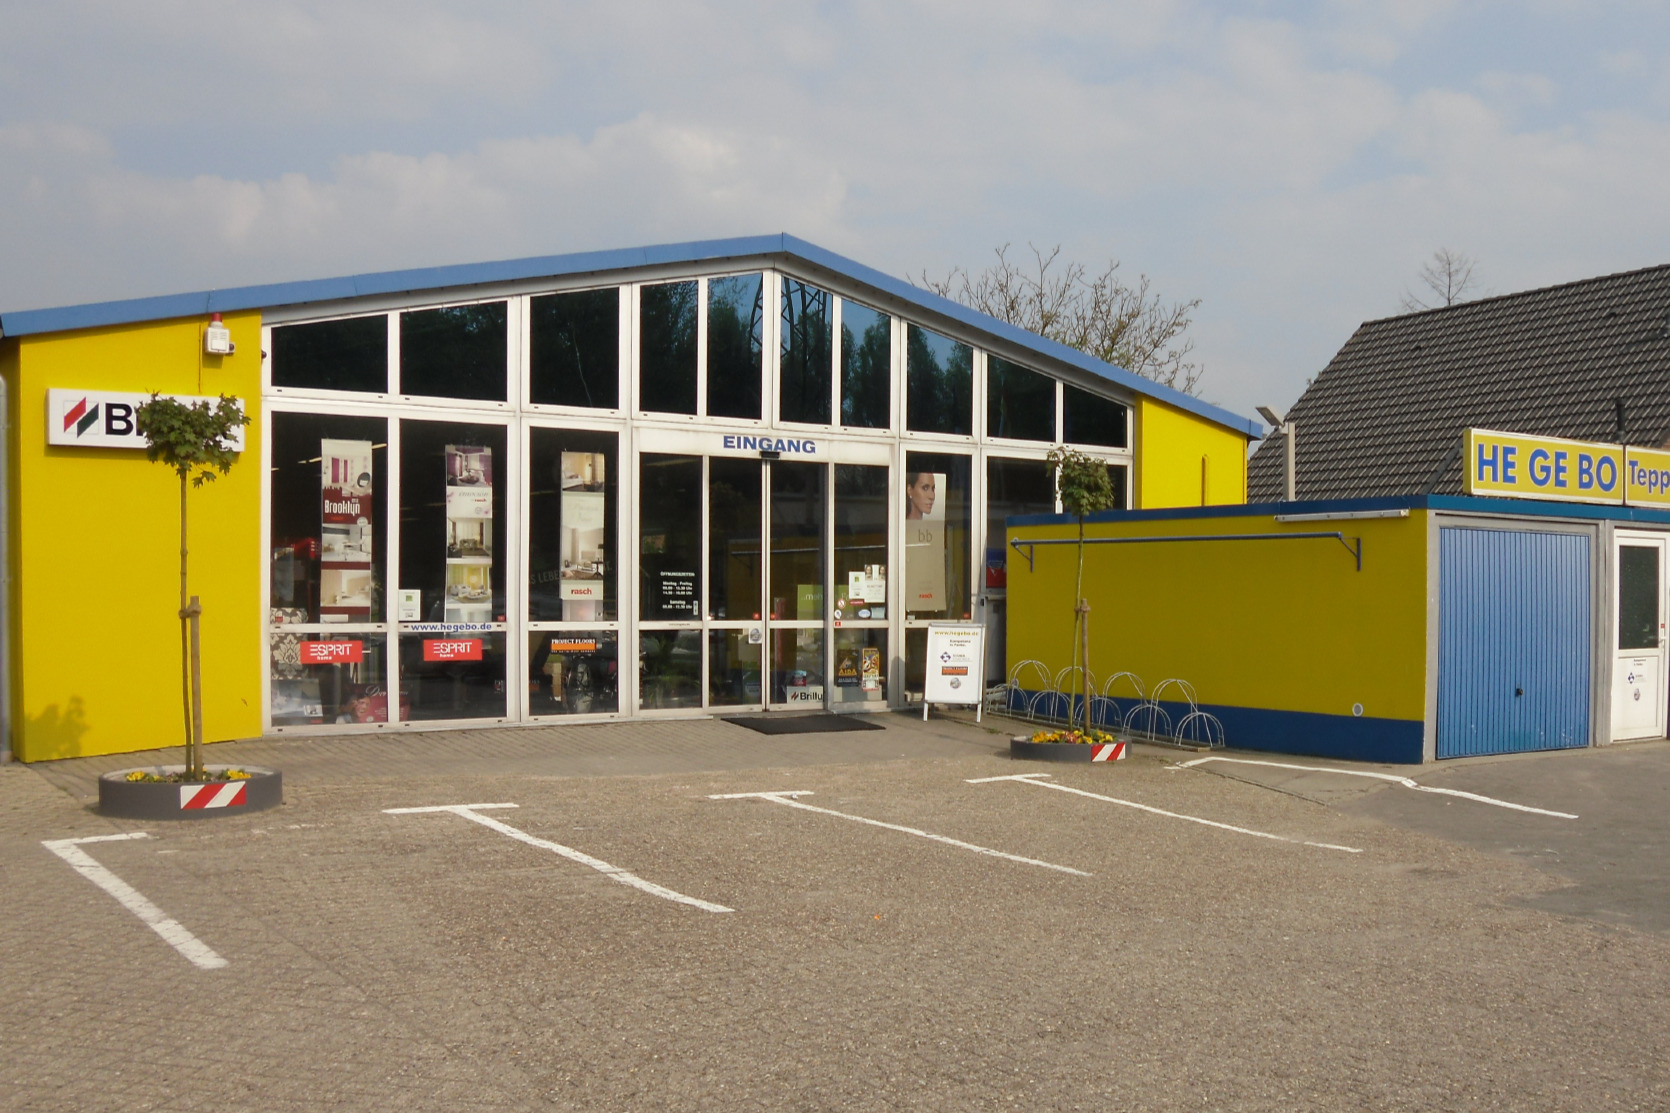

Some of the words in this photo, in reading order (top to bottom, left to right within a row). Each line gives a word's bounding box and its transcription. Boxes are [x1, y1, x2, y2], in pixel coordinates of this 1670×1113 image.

[723, 435, 816, 454] EINGANG
[1477, 443, 1518, 485] HE
[1528, 448, 1568, 488] GE
[1578, 453, 1618, 492] BO
[1628, 460, 1670, 494] Tepp
[324, 499, 361, 517] Brooklyn
[571, 587, 592, 595] rasch
[411, 622, 492, 632] www.hegebo.de
[310, 643, 353, 656] ESPRIT
[433, 642, 473, 654] ESPRIT
[800, 692, 823, 700] Brillu
